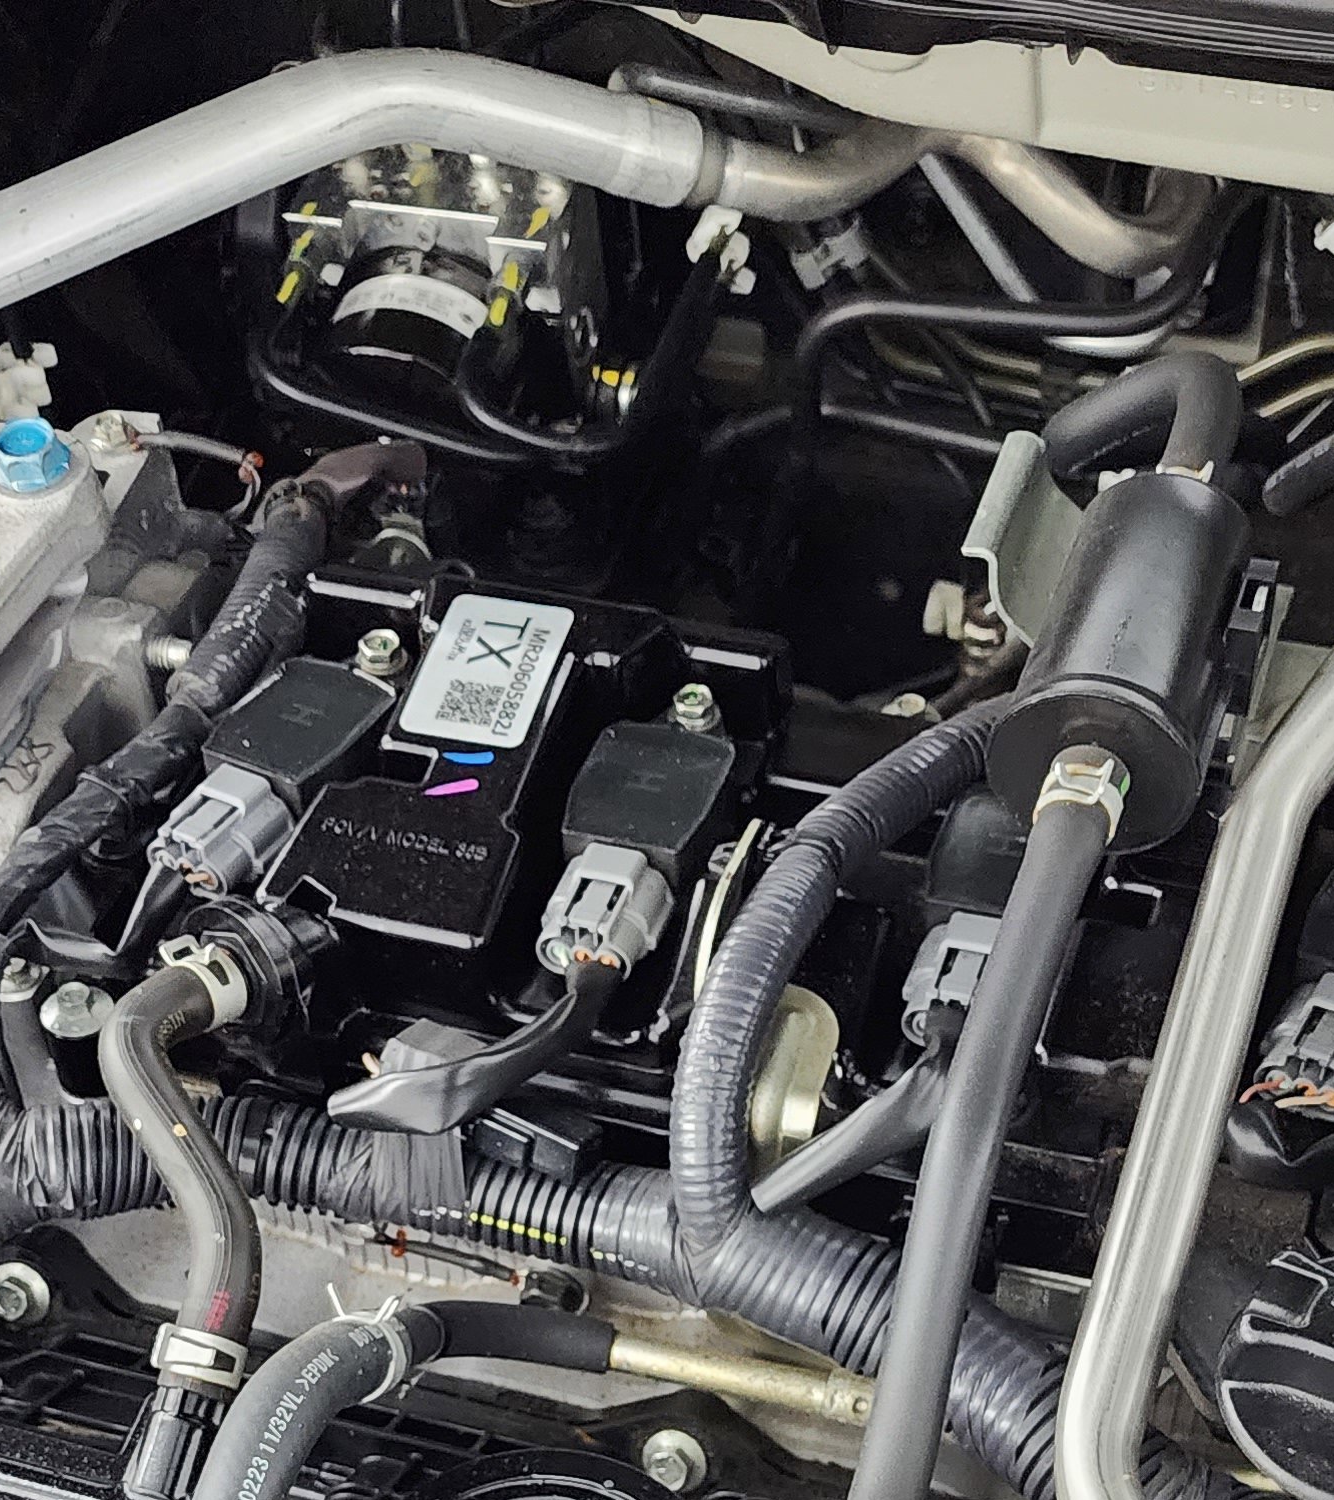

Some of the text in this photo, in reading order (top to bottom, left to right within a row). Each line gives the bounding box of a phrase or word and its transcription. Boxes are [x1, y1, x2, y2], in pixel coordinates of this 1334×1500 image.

[466, 617, 533, 669] TX
[491, 627, 551, 737] MR20605882J
[386, 828, 451, 857] MODEL
[295, 1348, 340, 1392] >EPDM<
